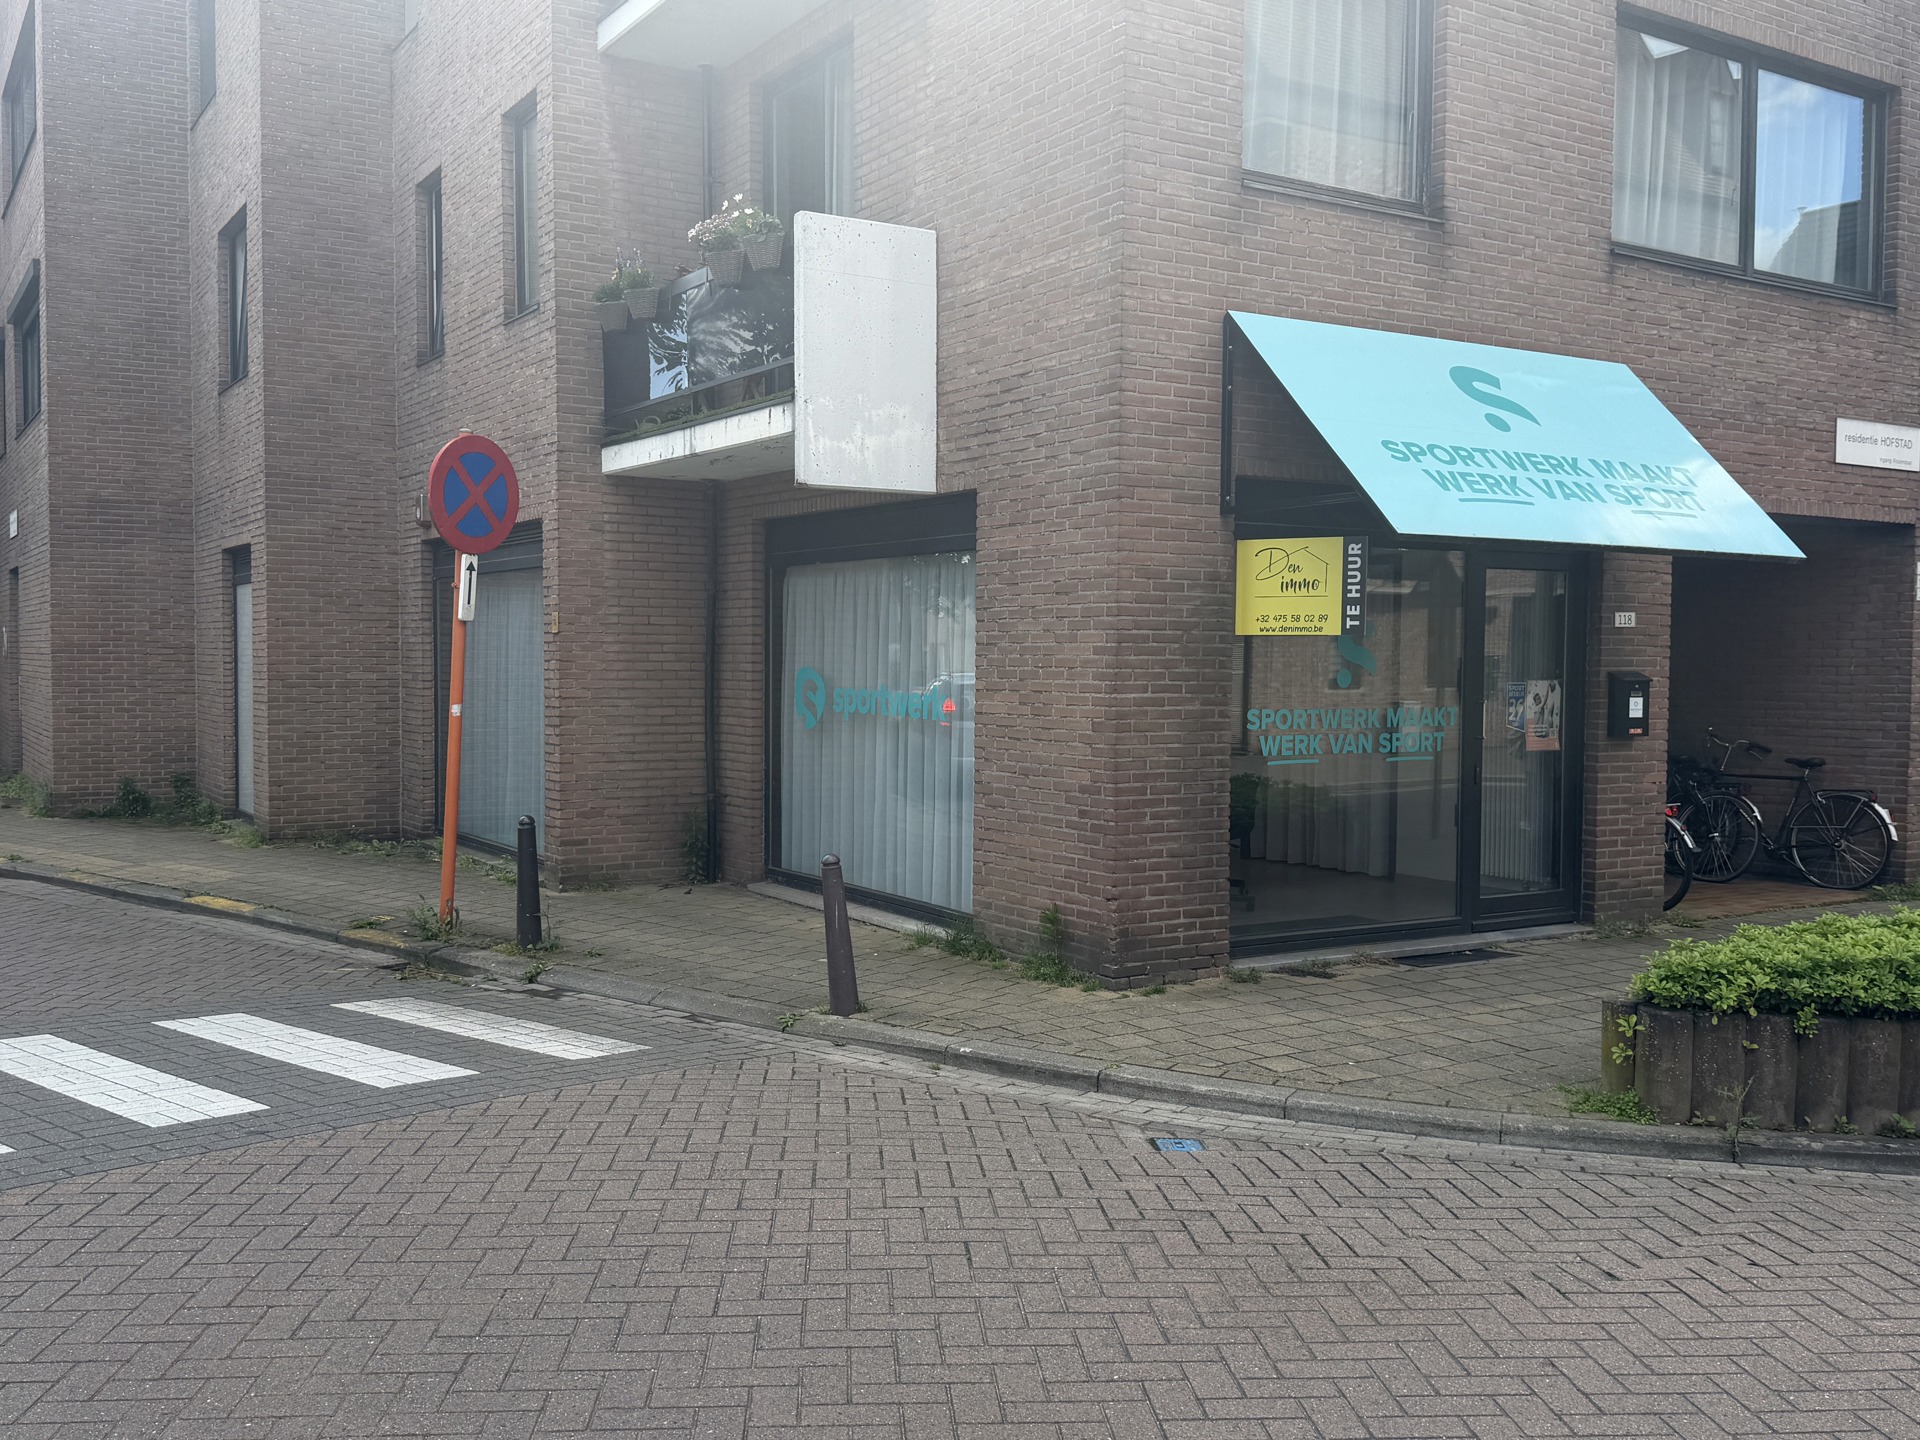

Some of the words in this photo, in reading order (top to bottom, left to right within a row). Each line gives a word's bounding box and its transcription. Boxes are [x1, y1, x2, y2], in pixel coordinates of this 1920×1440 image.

[1844, 433, 1878, 446] residentie
[1880, 437, 1913, 449] HOFSTAD
[1381, 440, 1593, 478] SPORTWERK
[1588, 458, 1699, 488] MAAKT
[1421, 469, 1535, 498] WERK
[1528, 477, 1608, 503] VAN
[1605, 483, 1707, 511] SPORT
[1255, 547, 1304, 581] Den
[1347, 543, 1362, 597] HUUR
[1280, 576, 1321, 594] immo
[1255, 614, 1270, 623] +32
[1273, 614, 1288, 623] 475
[1290, 614, 1301, 623] 58
[1303, 614, 1315, 622] 02
[1317, 614, 1329, 623] 89
[1259, 625, 1324, 633] www.denimmo.be
[1346, 605, 1360, 629] TE
[1618, 614, 1632, 625] 118
[833, 684, 948, 721] sportwerk
[1246, 708, 1381, 731] SPORTWERK
[1386, 706, 1459, 728] MAAKT
[1259, 734, 1323, 757] WERK
[1328, 733, 1373, 754] VAN
[1378, 732, 1445, 753] SPORT
